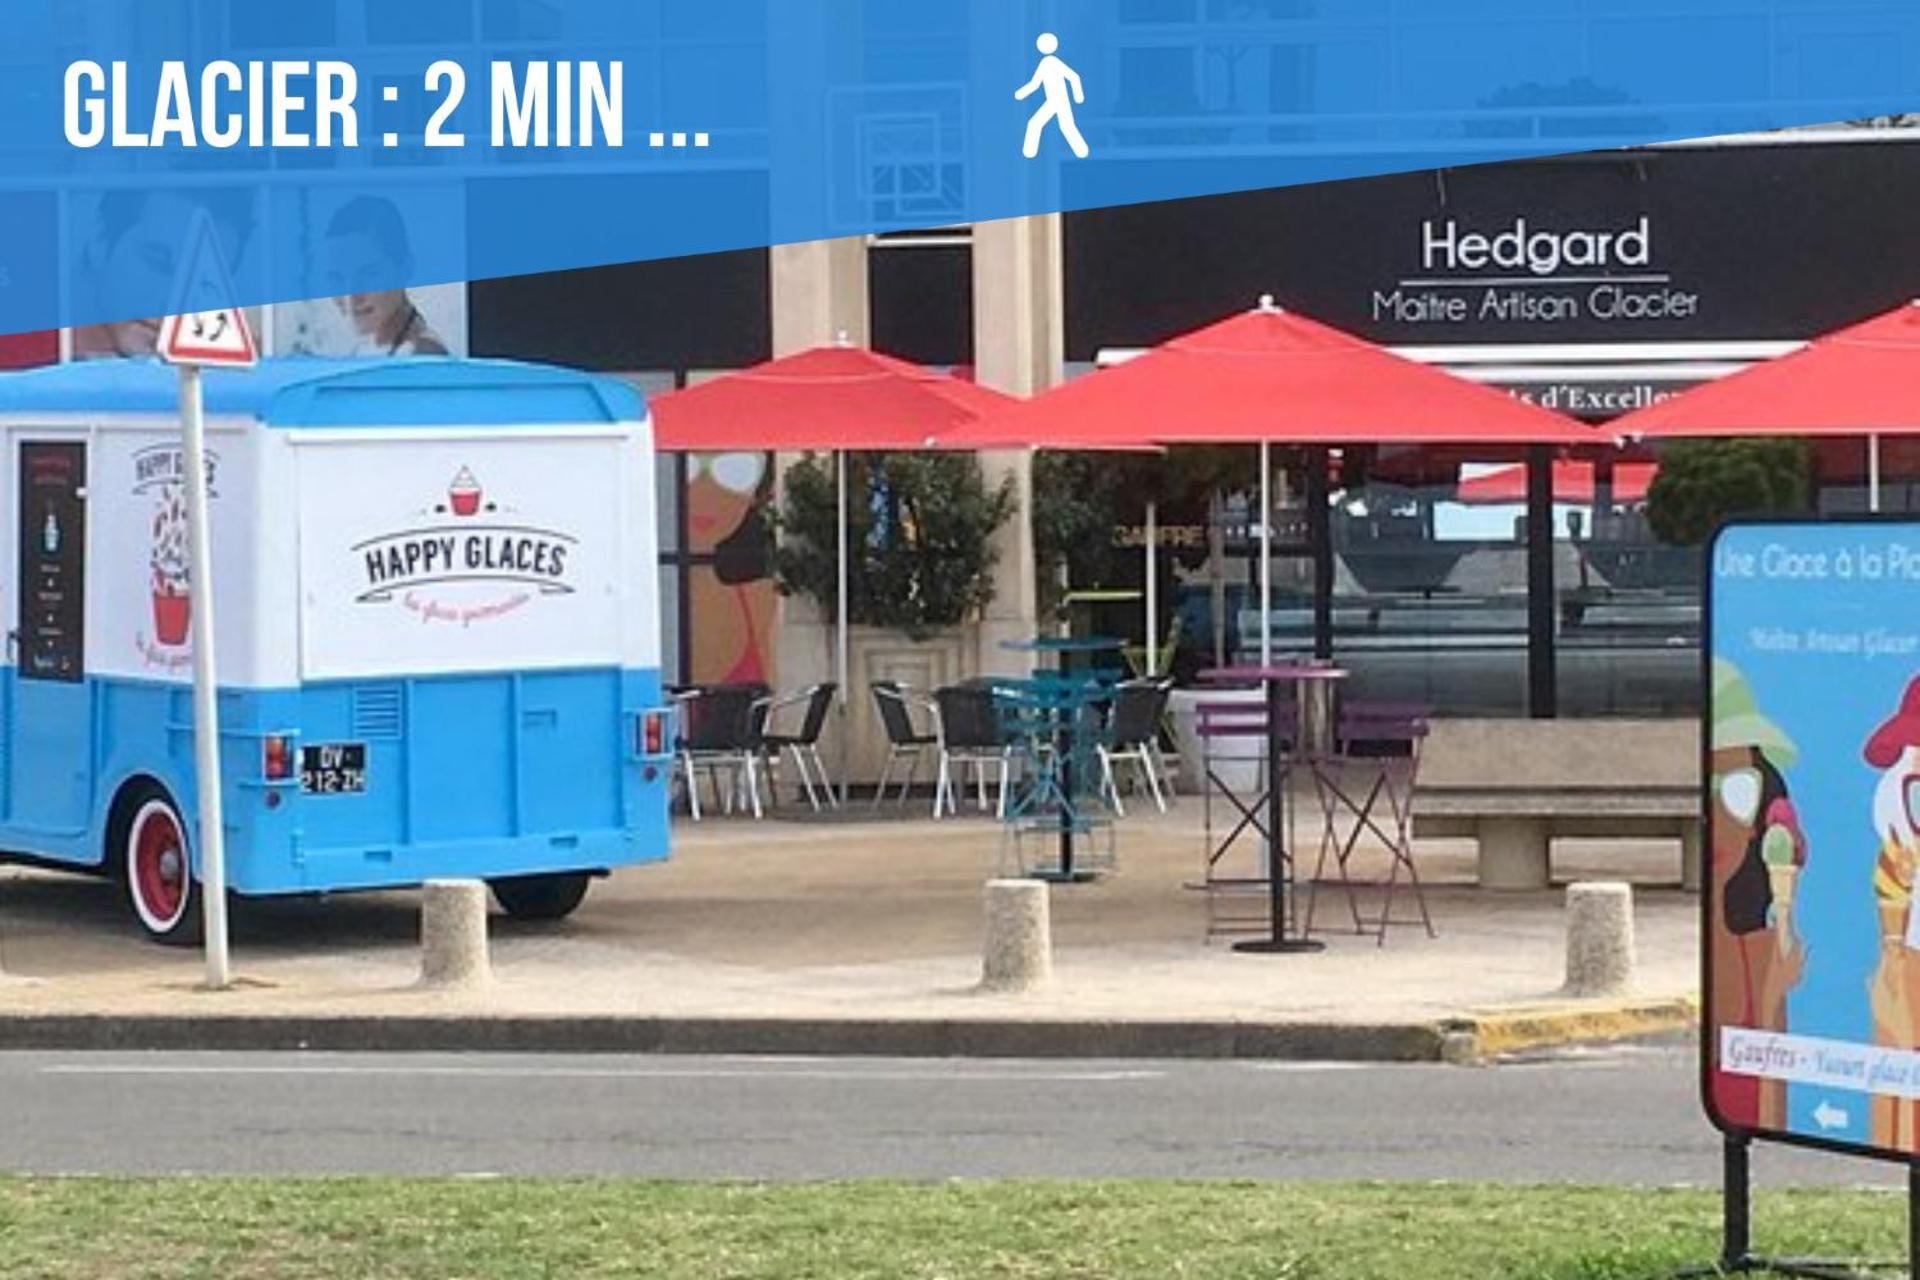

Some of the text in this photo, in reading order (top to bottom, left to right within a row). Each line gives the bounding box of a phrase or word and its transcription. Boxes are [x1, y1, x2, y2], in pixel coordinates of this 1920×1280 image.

[1424, 218, 1648, 274] Hedgard
[1477, 287, 1579, 321] Artisan
[1588, 285, 1698, 319] Glacier
[366, 535, 567, 583] HAPPY GLACES
[1859, 544, 1884, 578] la
